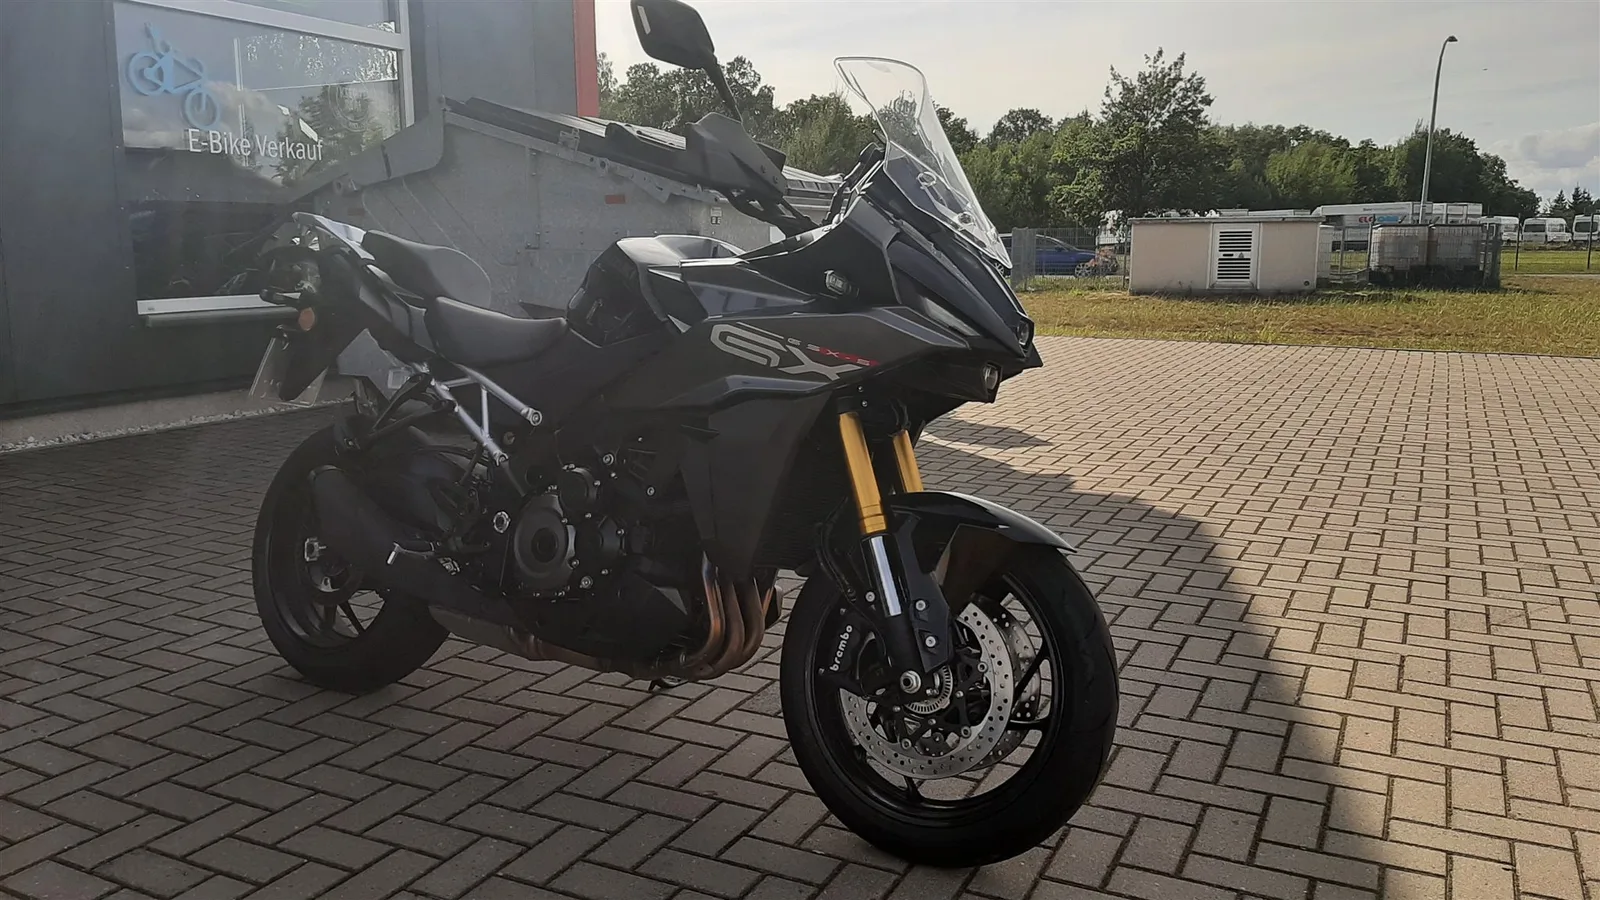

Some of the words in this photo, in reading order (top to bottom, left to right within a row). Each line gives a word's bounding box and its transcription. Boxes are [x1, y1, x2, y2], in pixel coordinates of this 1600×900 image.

[188, 128, 252, 156] E-Bike
[255, 134, 323, 161] Verkauf
[829, 625, 853, 671] brembo
